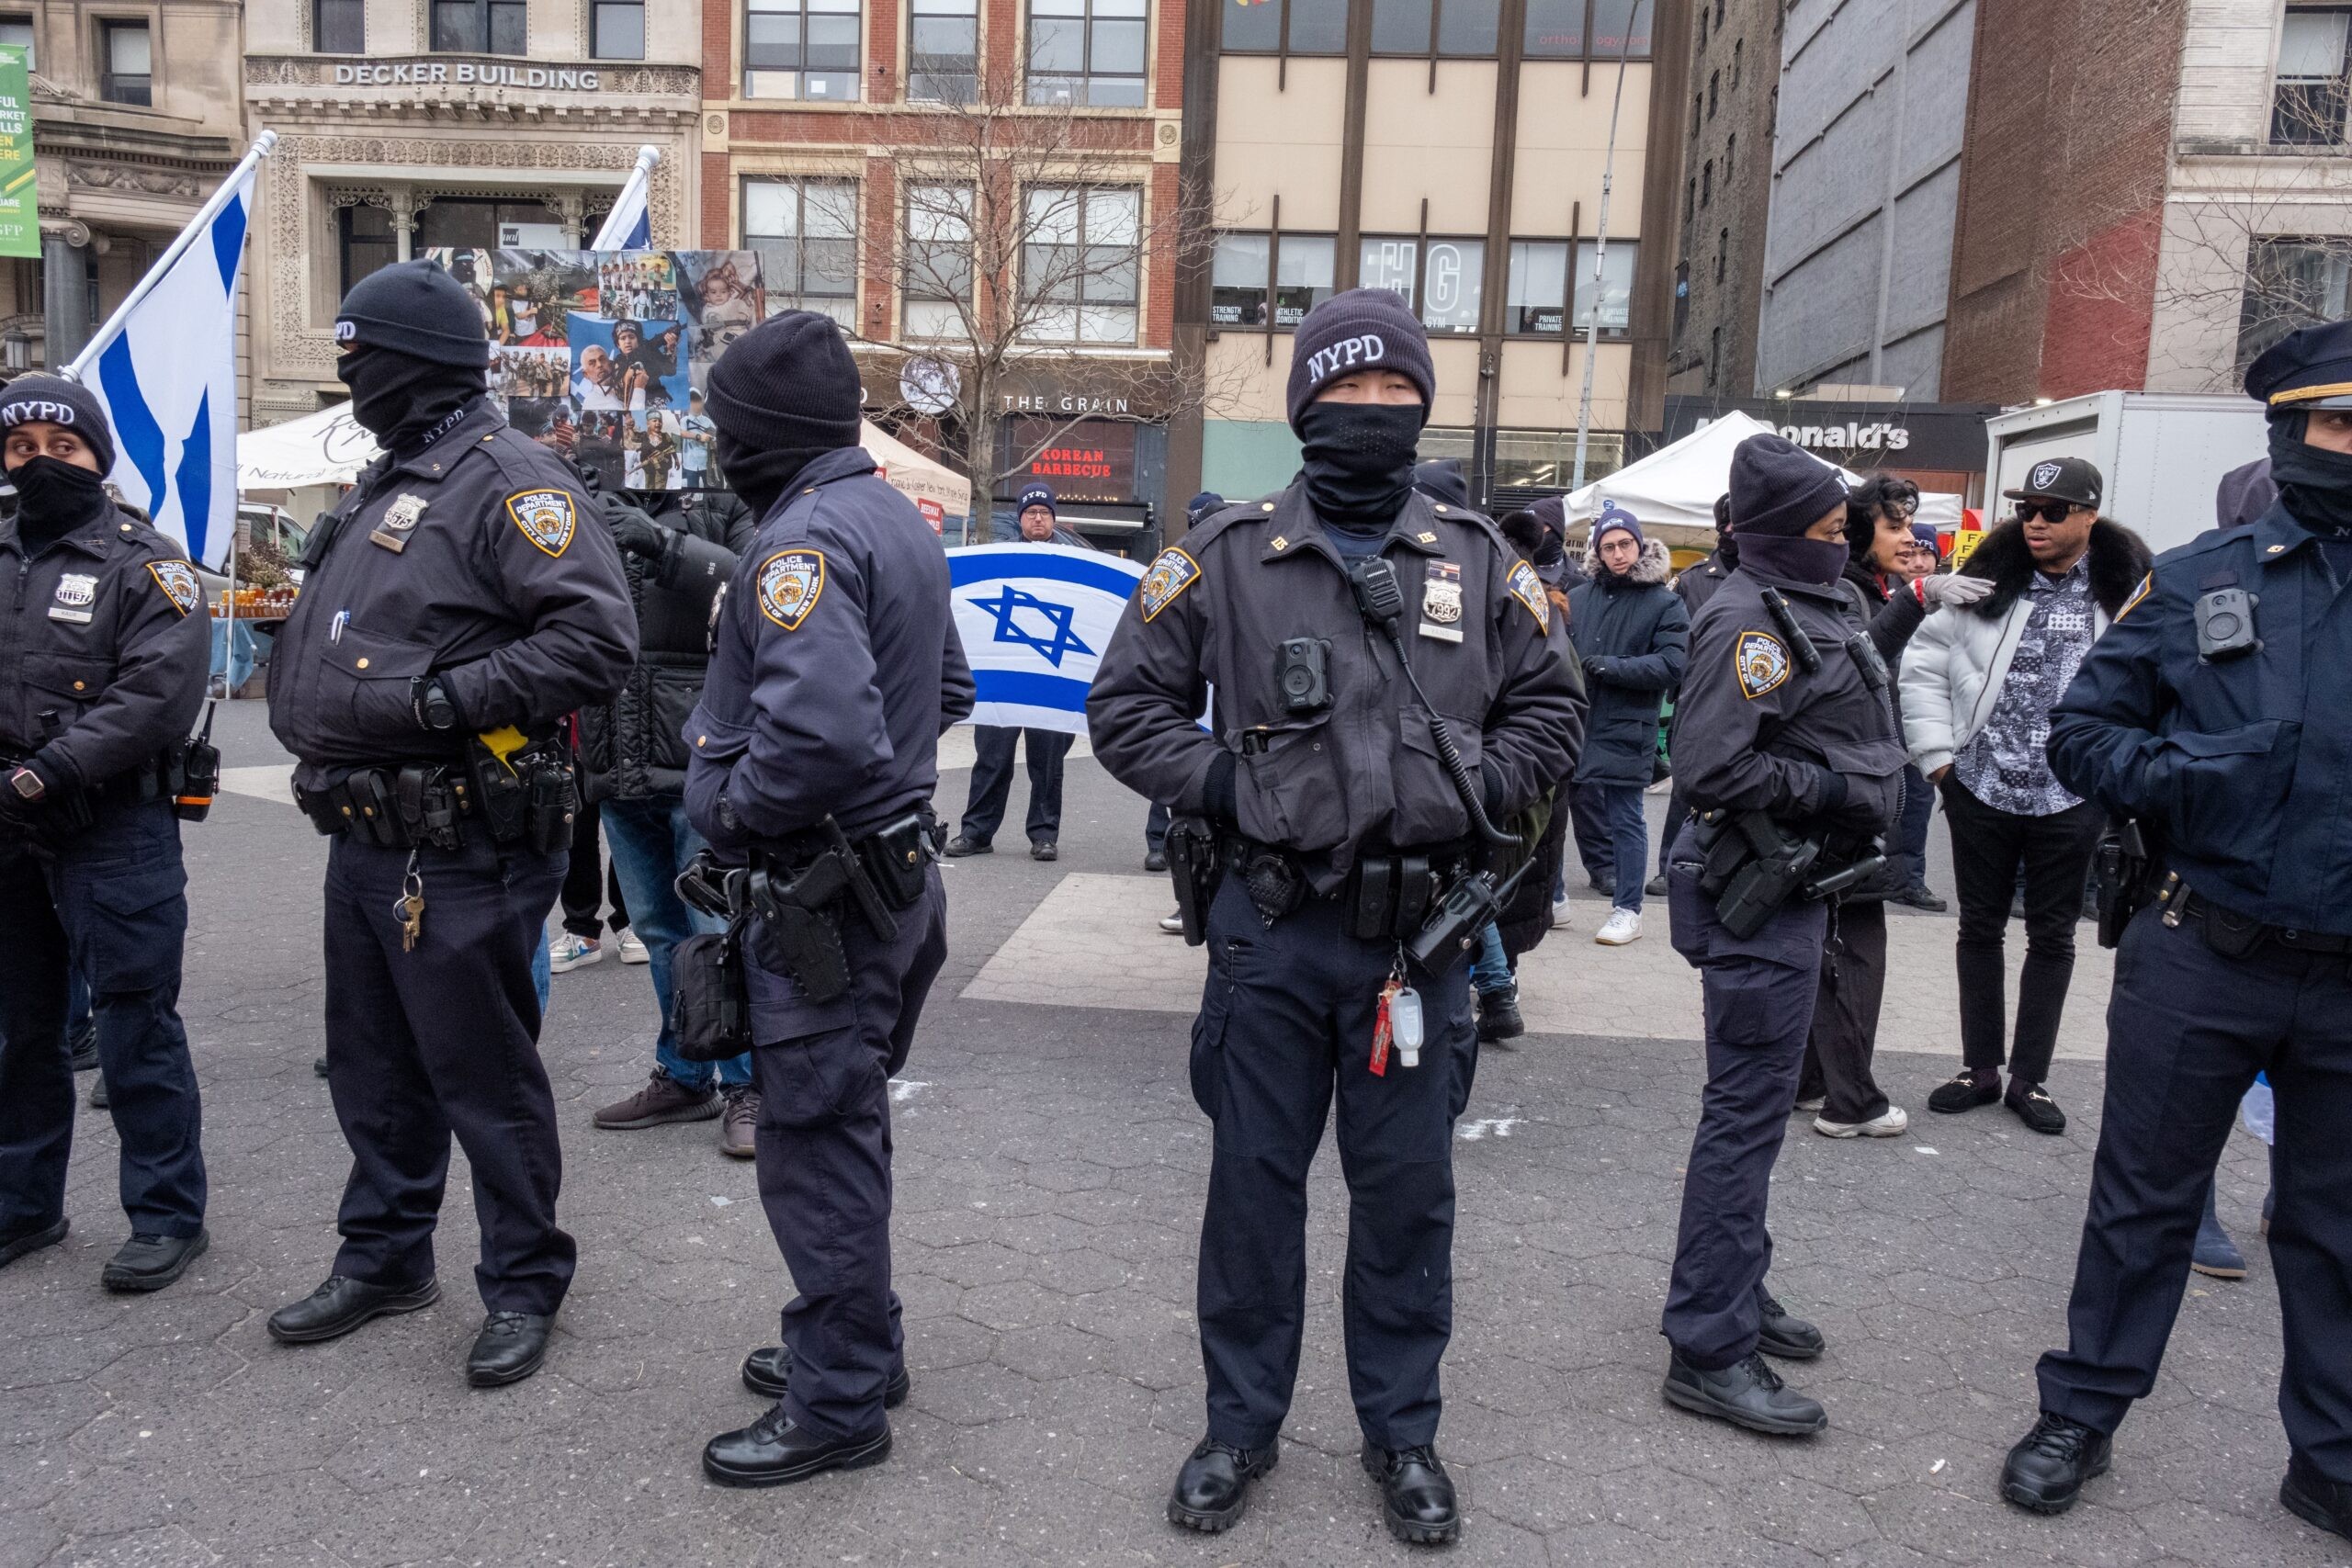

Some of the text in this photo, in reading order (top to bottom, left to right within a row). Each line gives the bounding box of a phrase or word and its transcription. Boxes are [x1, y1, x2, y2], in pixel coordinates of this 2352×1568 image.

[335, 62, 600, 89] DECKER BUILDING
[1212, 305, 1242, 315] STRENGTH
[1212, 313, 1239, 322] TRAINING
[1275, 308, 1304, 316] ATHLETIC
[1425, 315, 1446, 328] GYM
[1534, 322, 1562, 331] TRAINING
[1539, 315, 1563, 323] PRIVATE
[1306, 334, 1385, 384] NYPD
[1004, 396, 1044, 410] THE
[1060, 397, 1128, 412] GRAIN
[1, 400, 75, 427] NYPD
[422, 409, 464, 443] NYPD
[1040, 447, 1104, 461] KOREAN
[248, 467, 325, 480] Natural
[1031, 462, 1112, 477] BARBECUE
[523, 493, 554, 504] POLICE
[1022, 491, 1047, 503] NYPD
[515, 500, 567, 514] DEPARTMENT
[521, 520, 548, 547] CITY OF
[557, 511, 572, 547] NEW YORK
[770, 555, 803, 571] POLICE
[1165, 551, 1188, 568] POLICE
[761, 562, 817, 587] DEPARTMENT
[795, 575, 820, 618] NEW YORK
[1162, 582, 1182, 601] YORK
[762, 593, 783, 619] CITY OF
[1757, 637, 1781, 654] POLICE
[1744, 642, 1787, 666] DEPARTMENT
[1739, 655, 1747, 672] CITY
[1770, 669, 1787, 684] YORK
